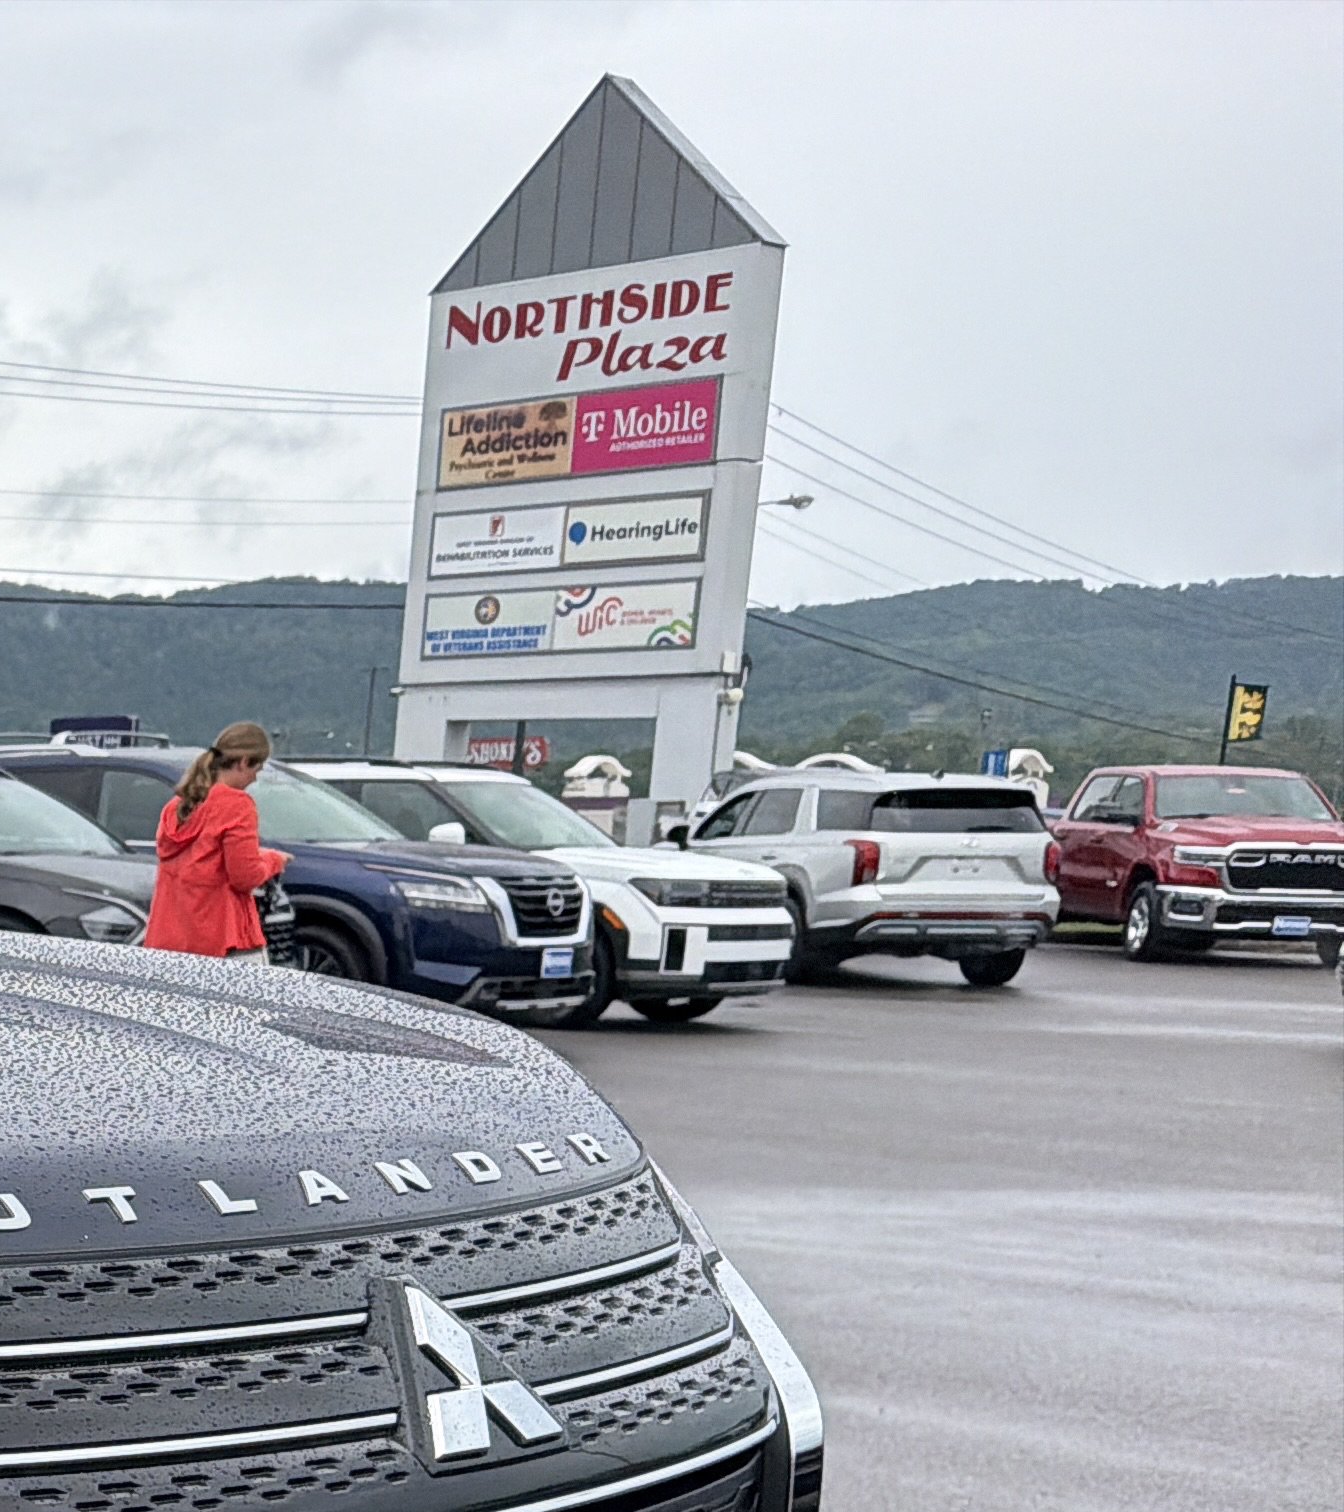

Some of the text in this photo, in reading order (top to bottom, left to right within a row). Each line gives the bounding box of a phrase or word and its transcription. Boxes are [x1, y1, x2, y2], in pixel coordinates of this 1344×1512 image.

[446, 271, 733, 350] NORTHSIDE
[556, 330, 727, 382] Plaza
[448, 411, 526, 437] Lifeline
[610, 400, 708, 440] Mobile
[460, 428, 568, 457] Addiction
[590, 517, 699, 541] HearingLife
[1268, 853, 1337, 865] RAM
